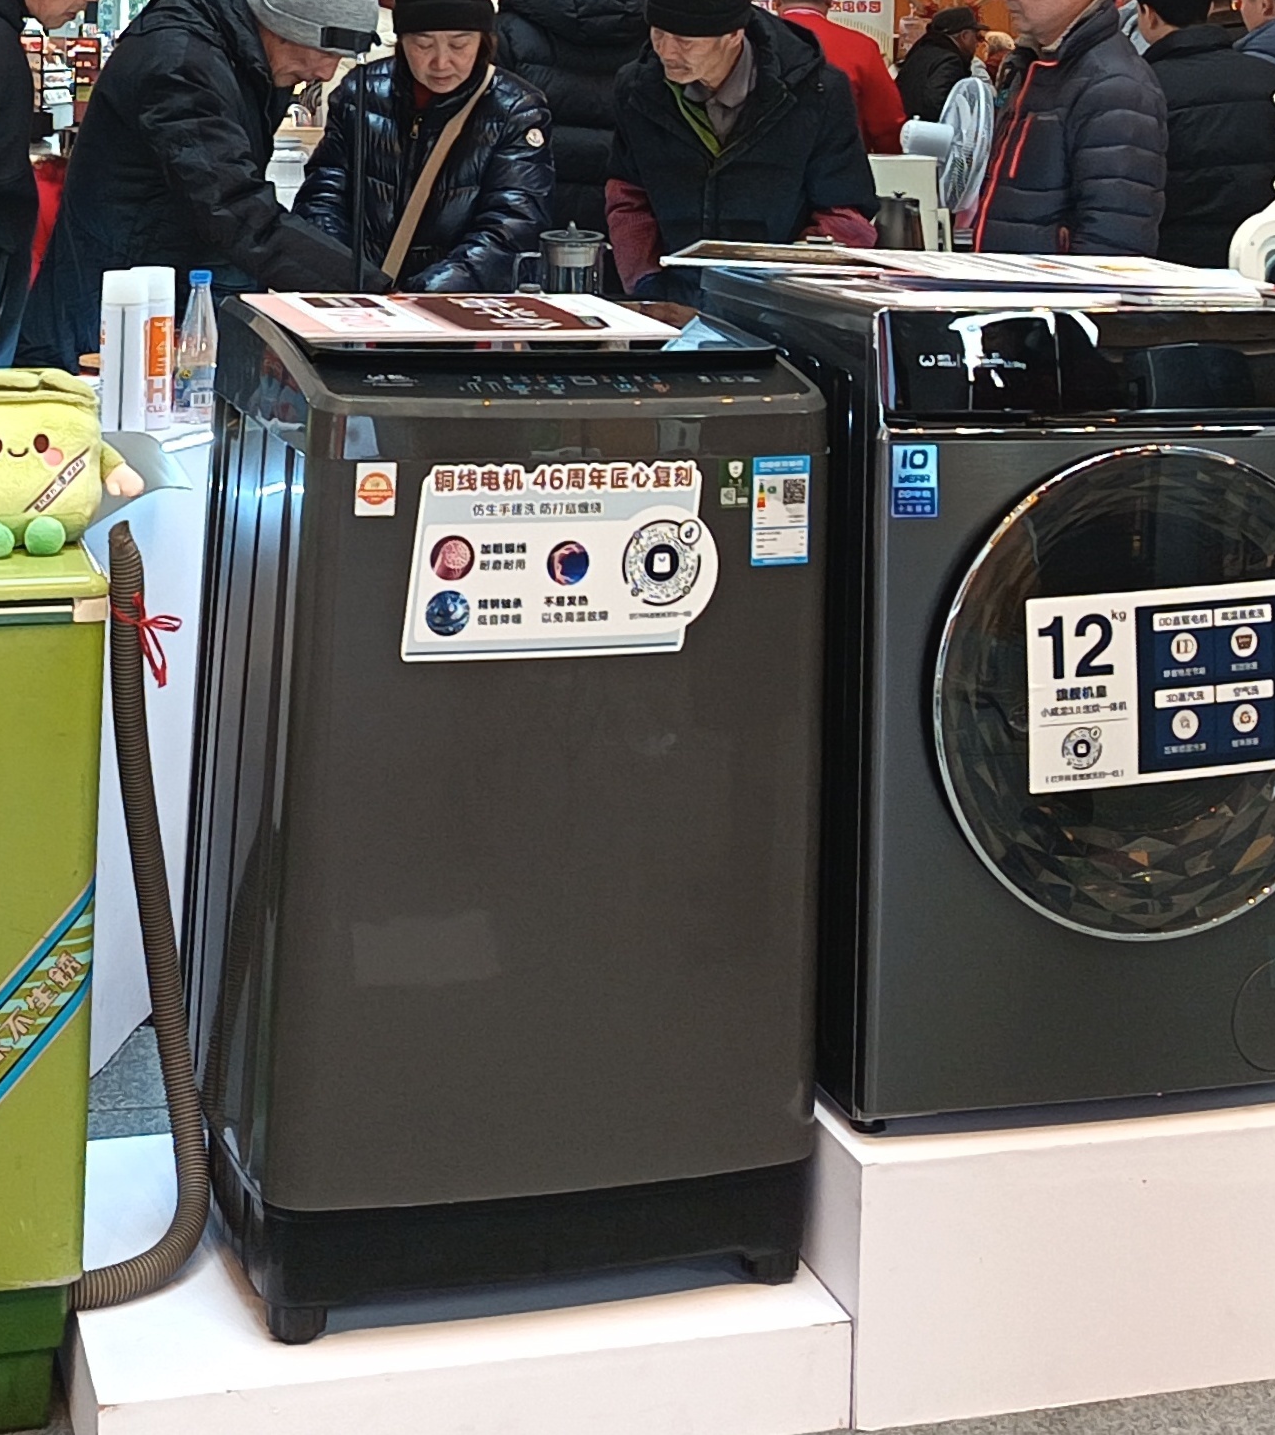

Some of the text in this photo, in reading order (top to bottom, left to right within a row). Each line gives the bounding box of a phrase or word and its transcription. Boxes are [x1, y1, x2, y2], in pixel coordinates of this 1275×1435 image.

[901, 449, 928, 470] 10
[434, 465, 693, 492] 铜线电机 46周年匠心复刻
[1037, 609, 1127, 680] 12 kg
